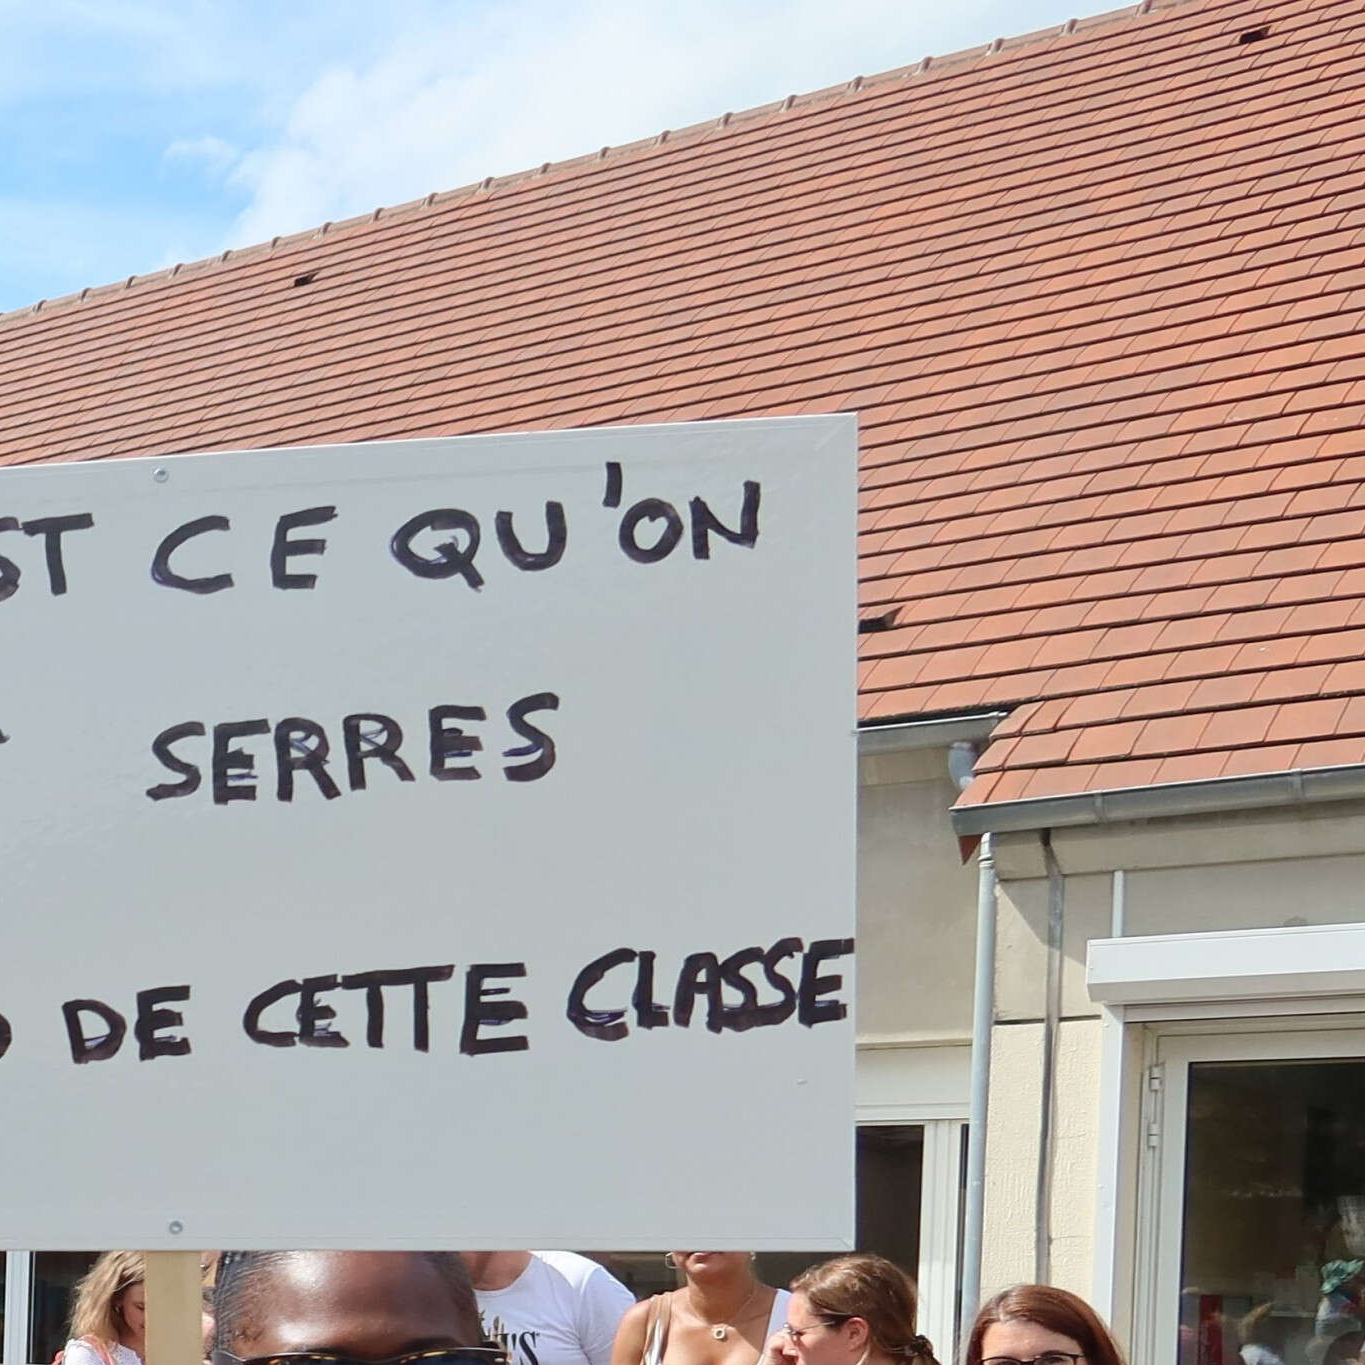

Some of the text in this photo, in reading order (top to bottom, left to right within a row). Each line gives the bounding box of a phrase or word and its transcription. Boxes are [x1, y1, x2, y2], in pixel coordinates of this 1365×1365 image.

[391, 461, 760, 592] QU'ON
[146, 692, 560, 804] SERRES
[63, 985, 191, 1064] DE
[244, 962, 529, 1056] CETTE
[566, 937, 856, 1042] CLASSE
